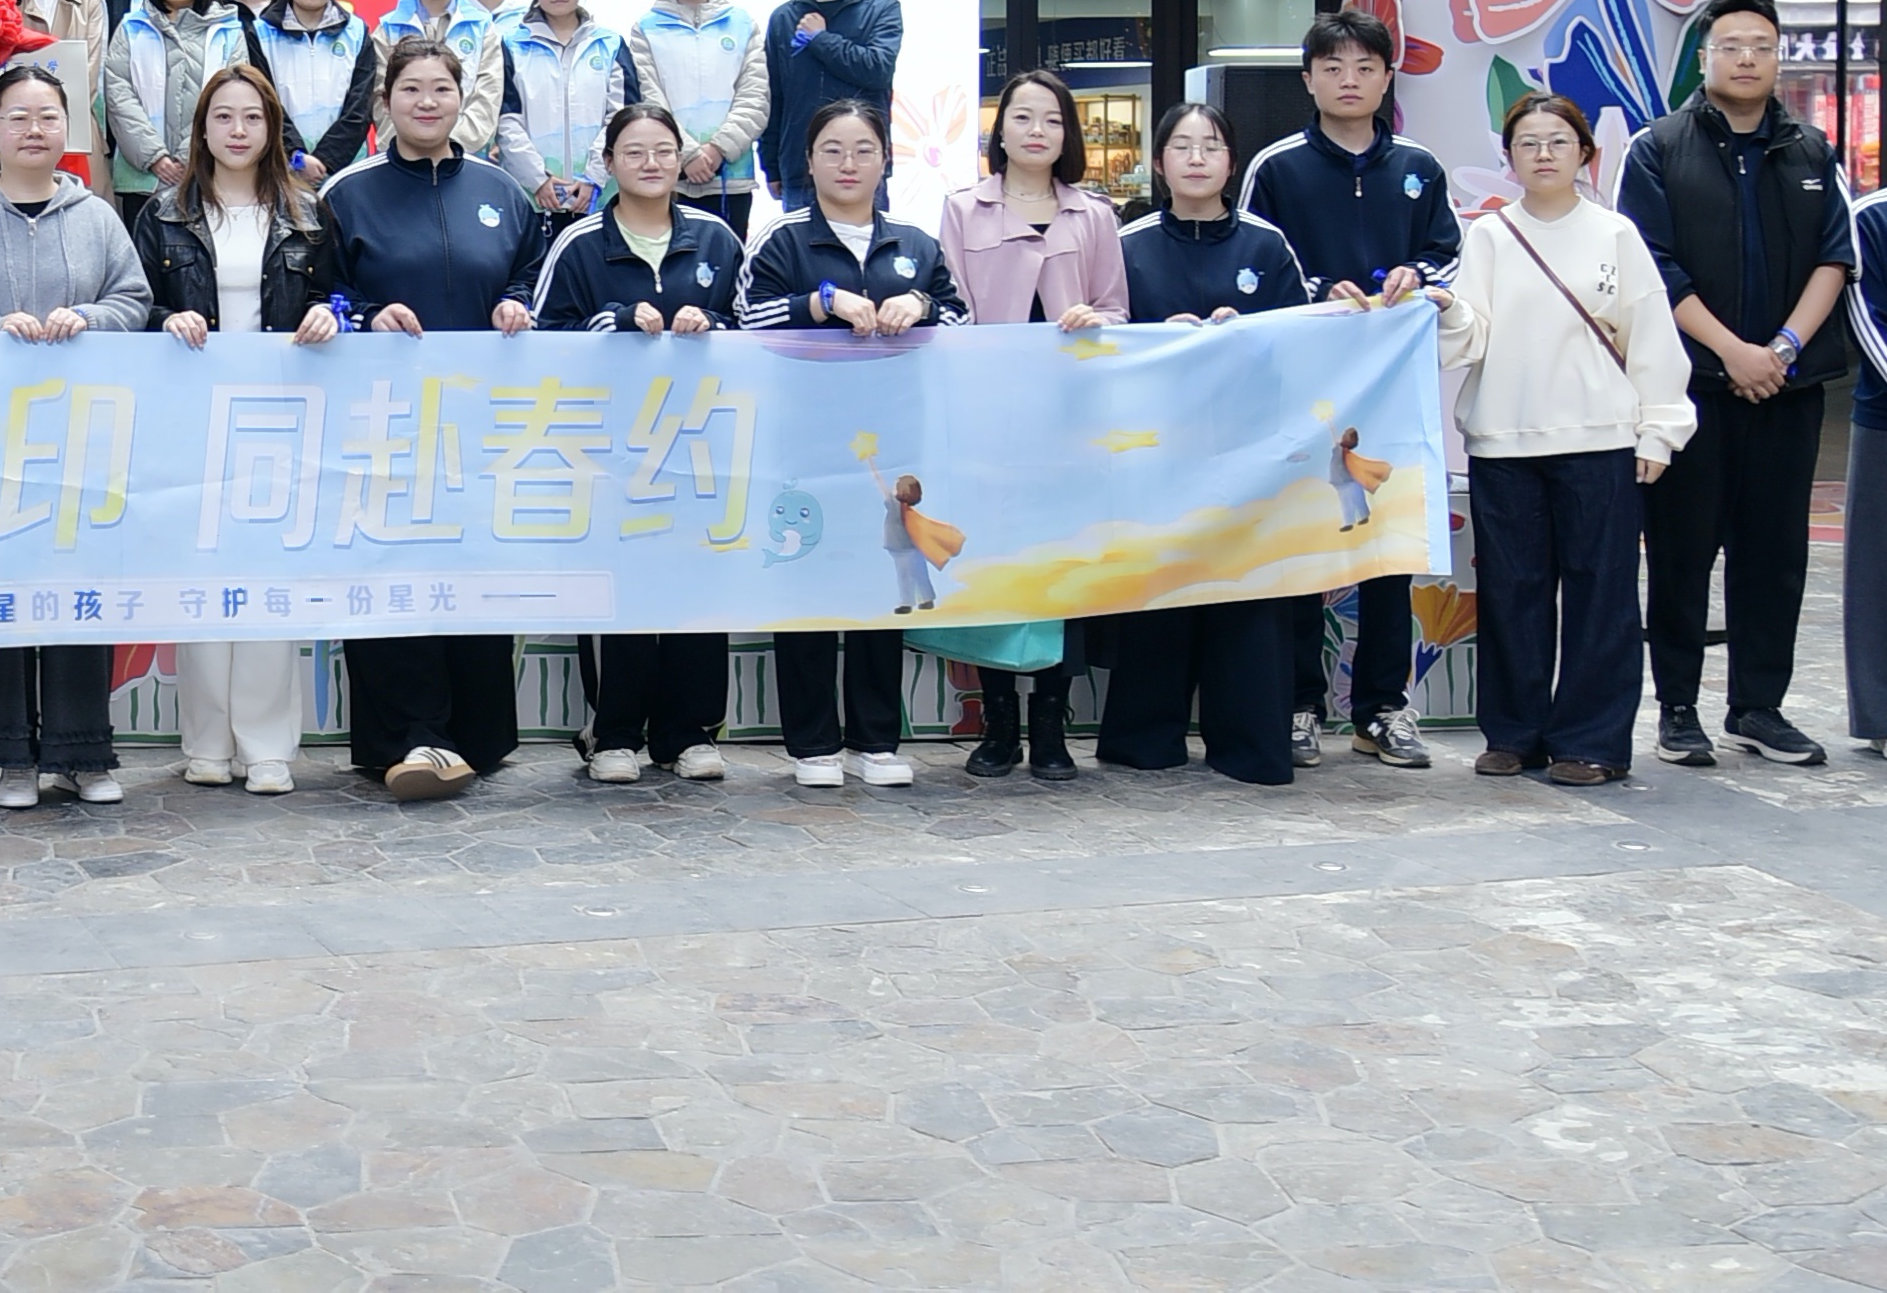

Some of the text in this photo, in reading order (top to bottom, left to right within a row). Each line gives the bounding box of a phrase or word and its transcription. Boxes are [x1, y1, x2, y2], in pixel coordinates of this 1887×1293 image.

[196, 376, 757, 551] 同赴春约
[179, 582, 458, 621] 守护每一份星光
